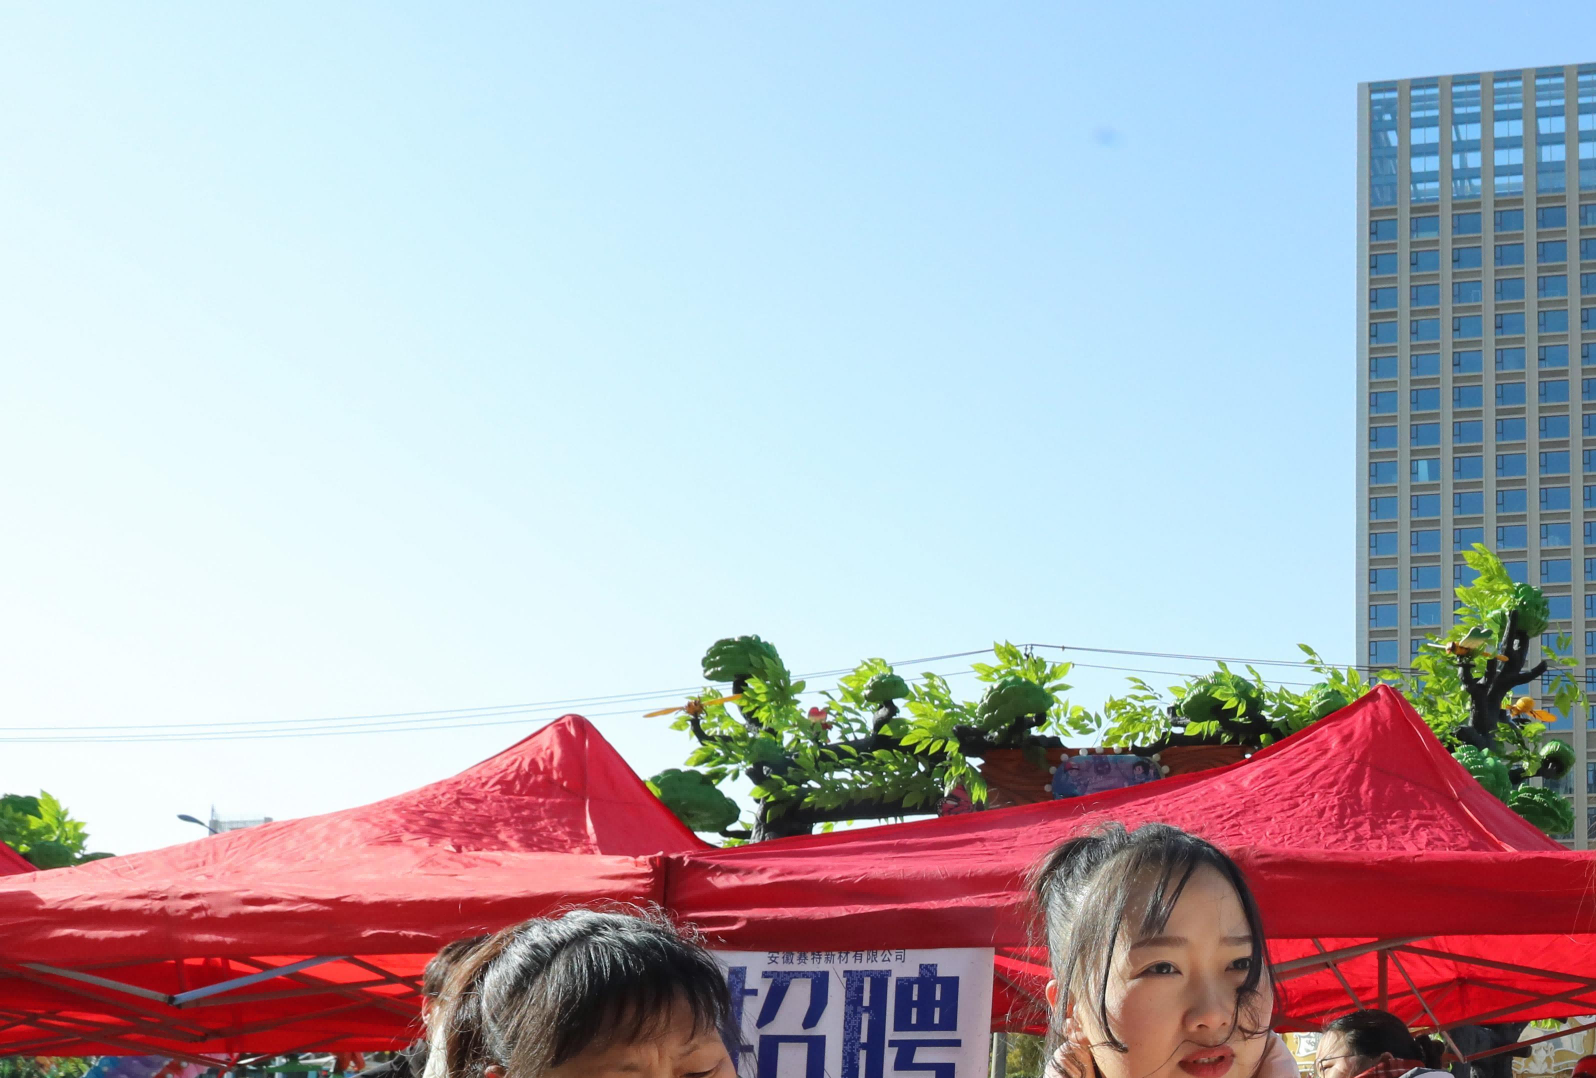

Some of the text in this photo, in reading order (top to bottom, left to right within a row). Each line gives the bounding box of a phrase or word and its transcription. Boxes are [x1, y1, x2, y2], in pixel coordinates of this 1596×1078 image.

[767, 949, 907, 965] 安徽赛特新材有限公司
